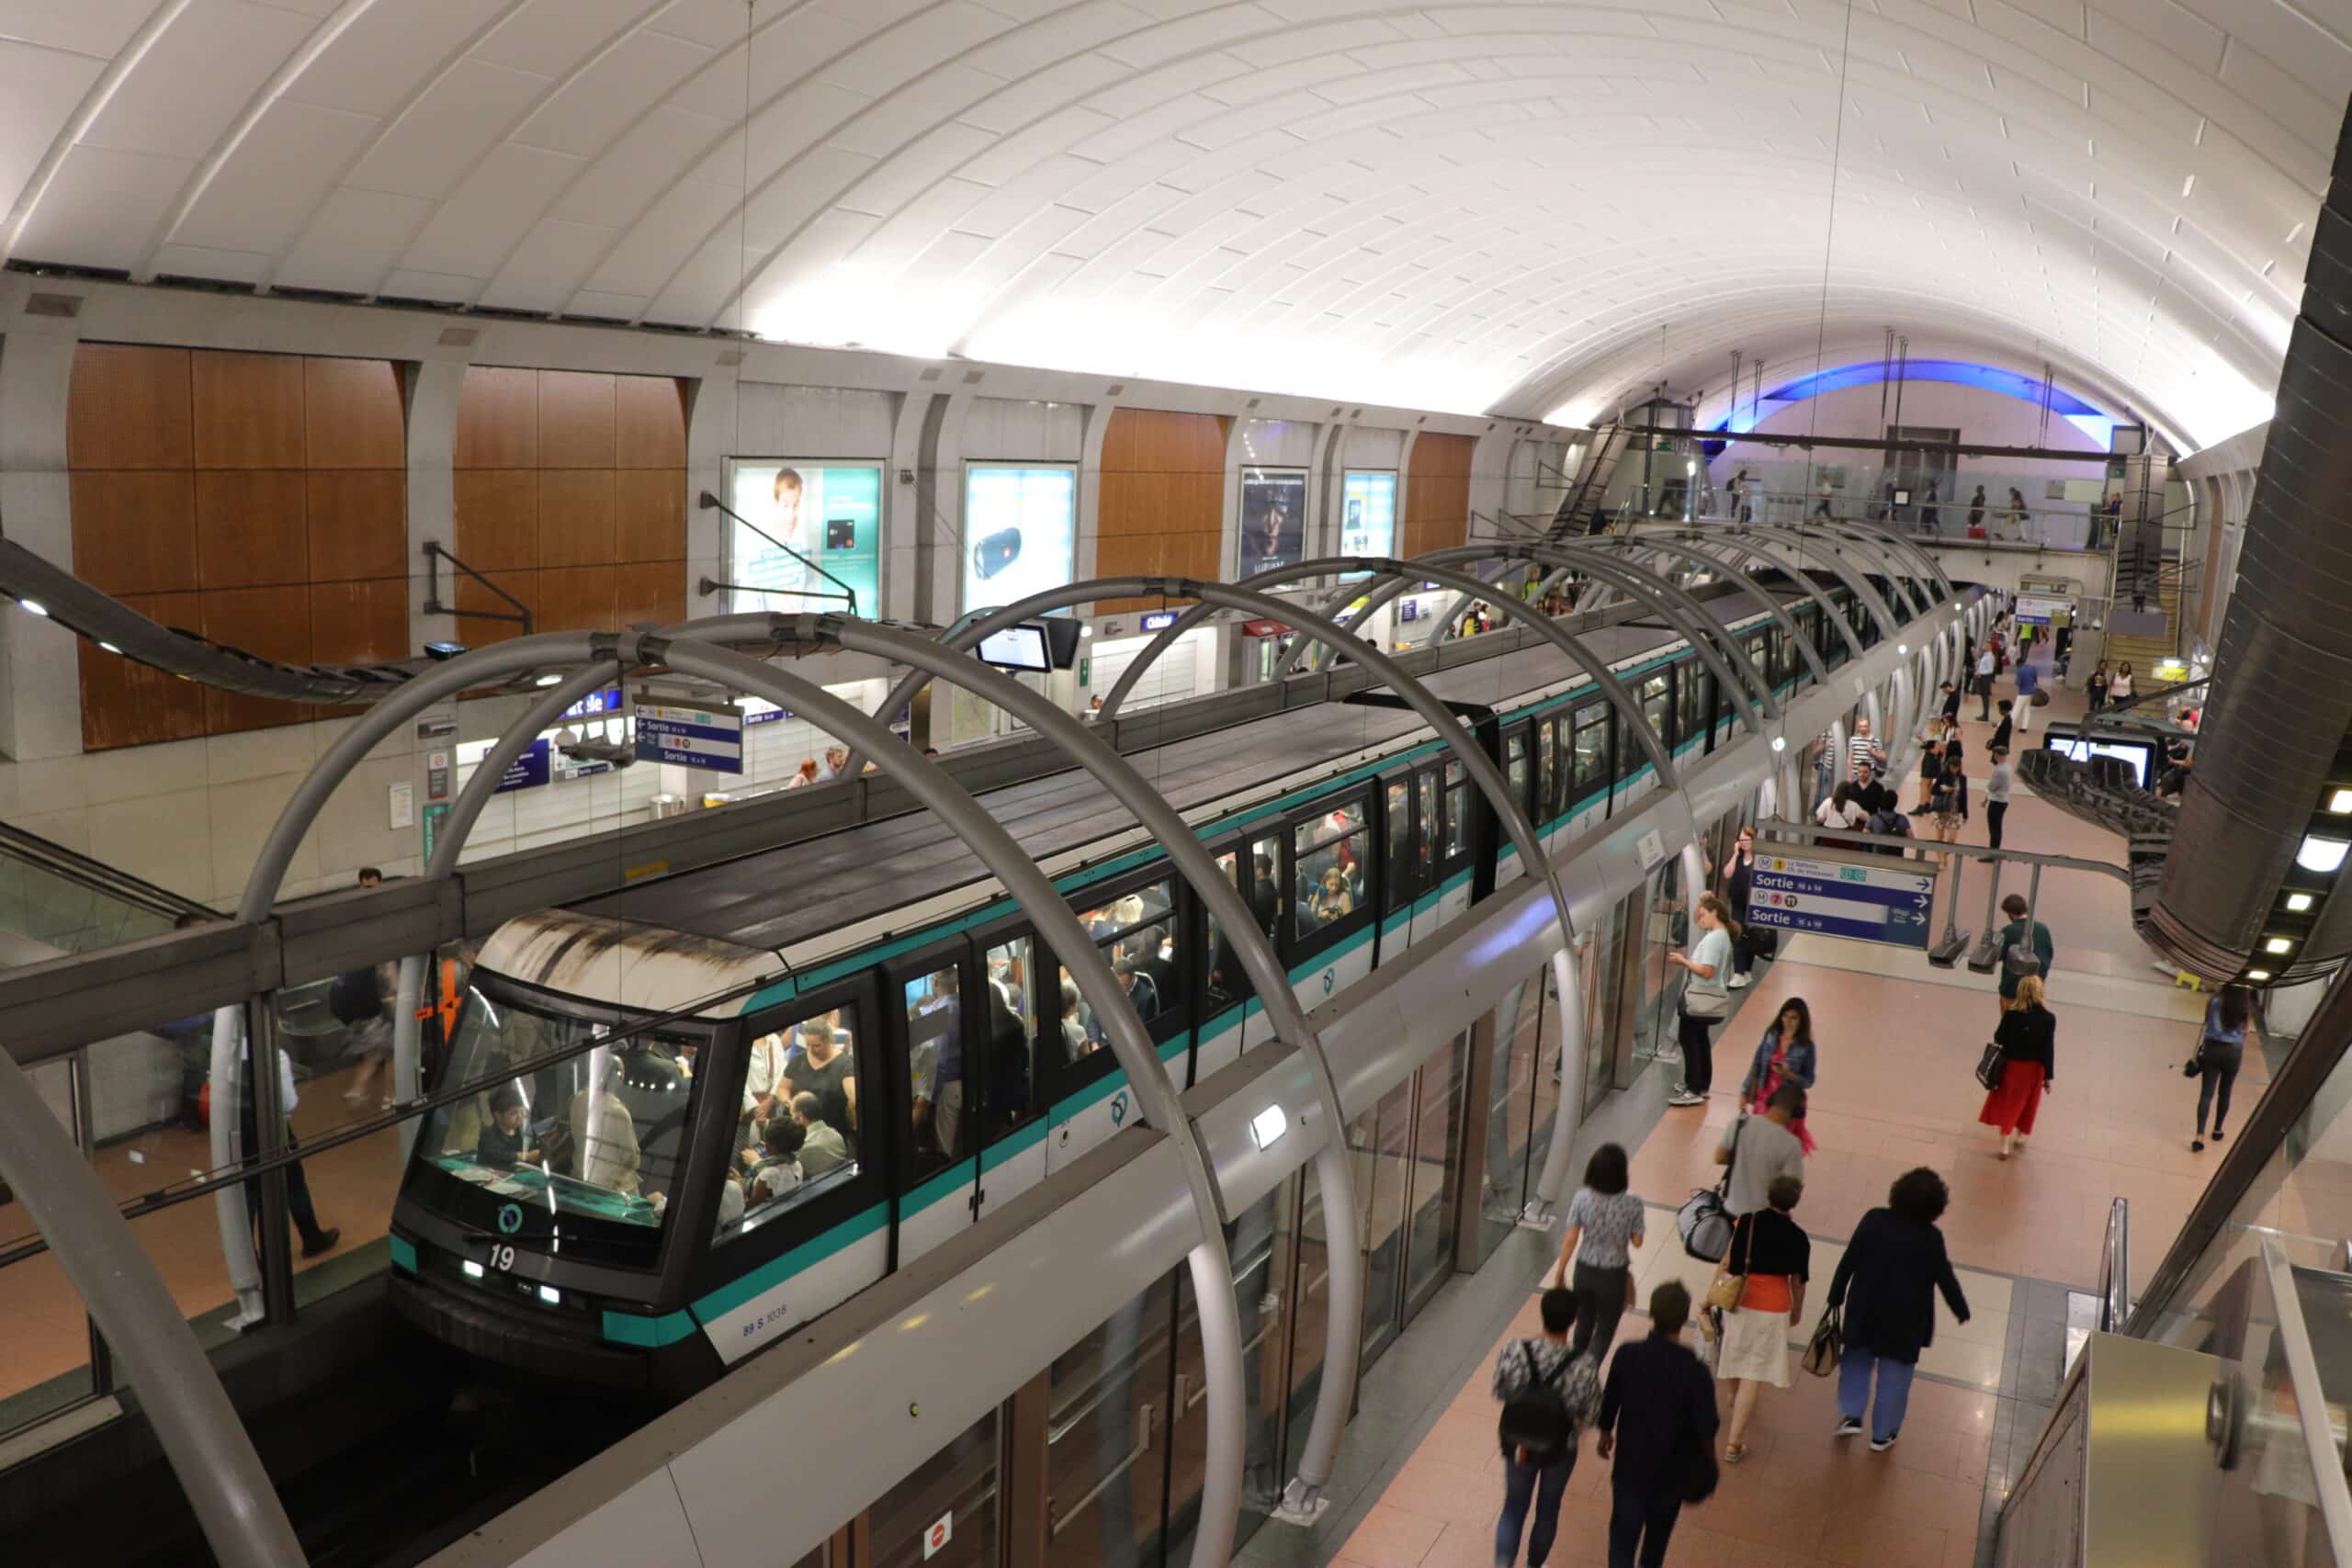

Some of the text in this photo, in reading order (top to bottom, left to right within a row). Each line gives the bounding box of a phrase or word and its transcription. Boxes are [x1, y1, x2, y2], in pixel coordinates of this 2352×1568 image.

[663, 750, 688, 762] Sortie
[1756, 874, 1794, 889] Sortie
[1752, 909, 1791, 925] Sortie
[490, 1243, 514, 1270] 19
[757, 1317, 764, 1329] S
